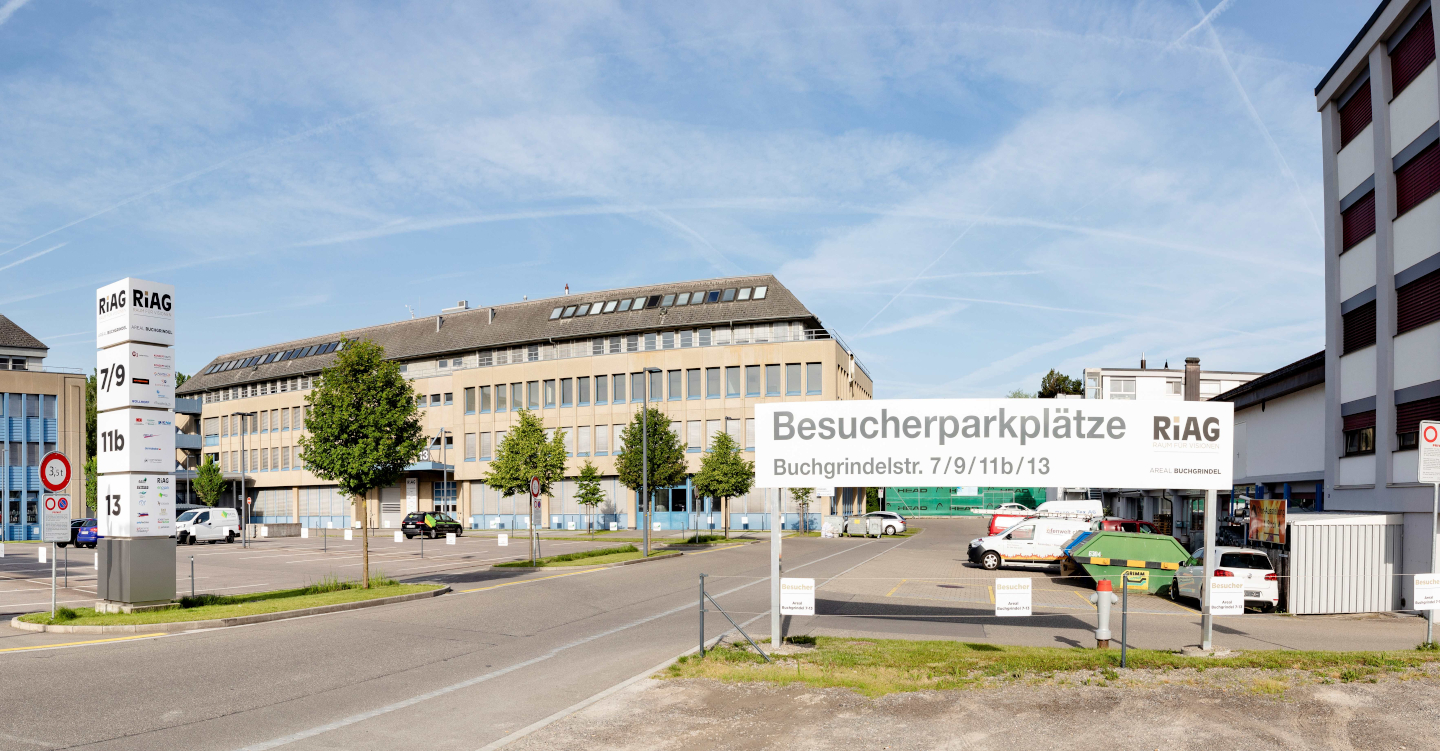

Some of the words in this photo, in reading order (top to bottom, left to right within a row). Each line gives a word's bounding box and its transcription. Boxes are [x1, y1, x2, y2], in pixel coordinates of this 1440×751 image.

[99, 290, 126, 315] RiAG
[133, 289, 172, 312] RiAG
[101, 363, 126, 393] 7/9
[773, 408, 1126, 446] Besucherparkplätze
[1153, 416, 1220, 442] RiAG
[102, 429, 125, 452] 11b
[419, 450, 428, 460] 13
[773, 457, 923, 479] Buchgrindelstr.
[105, 494, 121, 516] 13
[782, 583, 813, 591] Besucher
[996, 583, 1030, 591] Besucher
[1212, 582, 1243, 590] Besucher
[1415, 578, 1440, 586] Besuche
